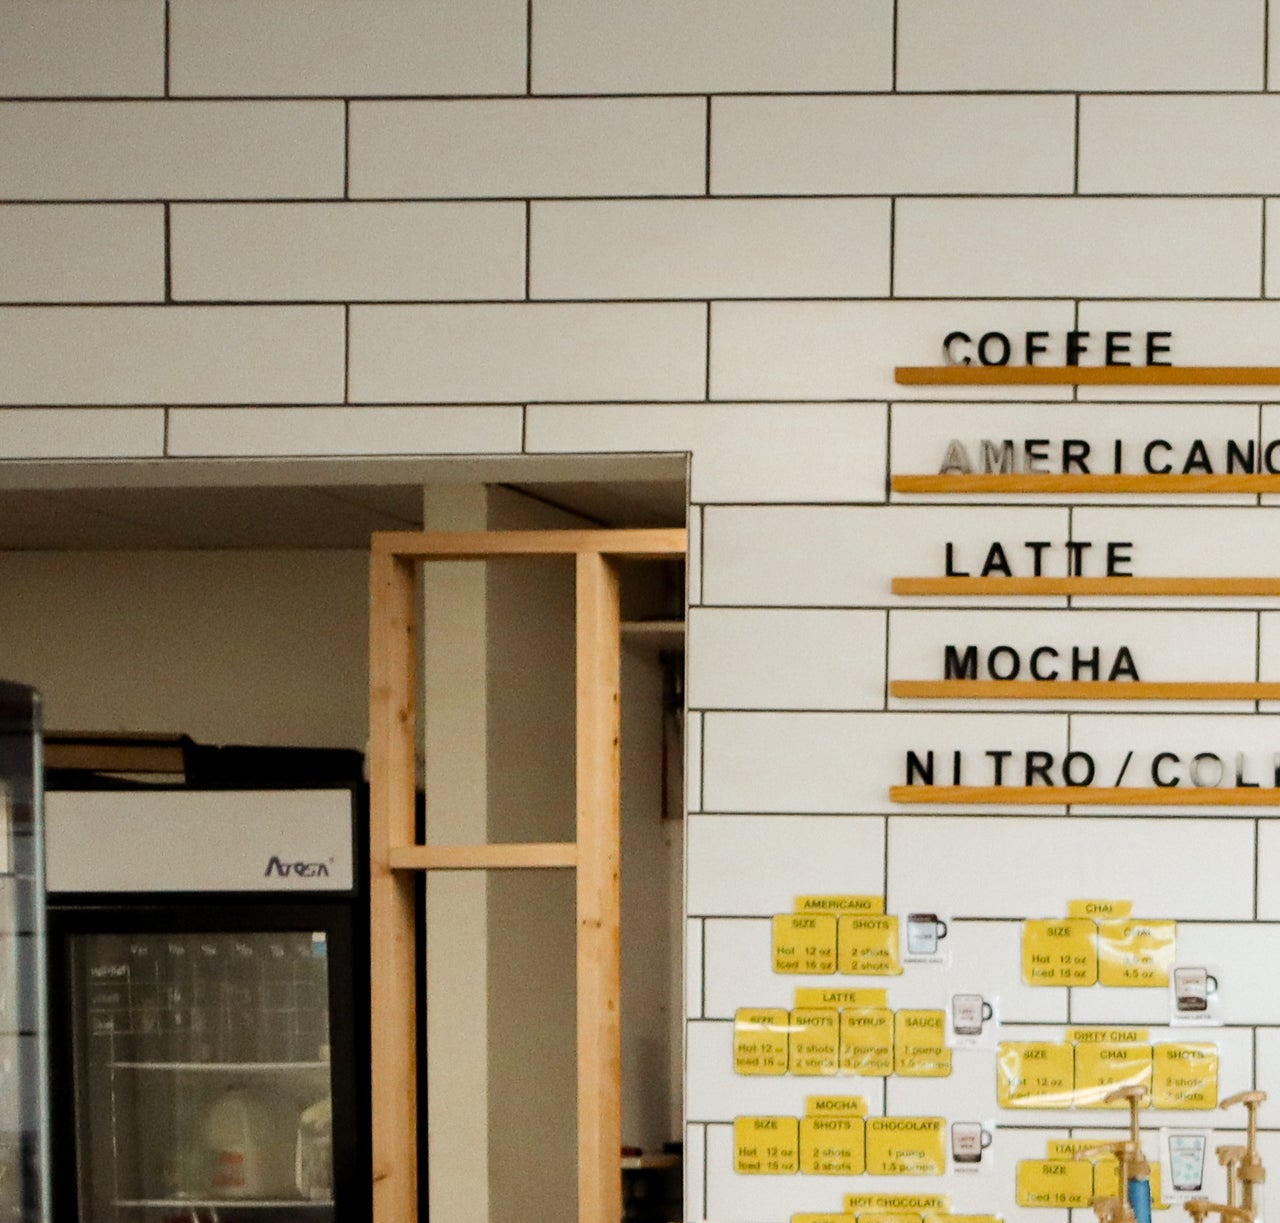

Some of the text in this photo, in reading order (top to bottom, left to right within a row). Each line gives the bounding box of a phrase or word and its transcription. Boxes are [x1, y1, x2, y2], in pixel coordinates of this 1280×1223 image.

[942, 331, 1173, 367] COFFEE
[944, 541, 1134, 578] LATTE
[944, 644, 1141, 681] MOCHA
[803, 899, 872, 911] AMERICANO
[1085, 904, 1113, 914] CHAI
[791, 919, 817, 930] SIZE
[851, 920, 890, 931] SHOTS
[1046, 928, 1072, 937] SIZE
[777, 946, 796, 957] Hot
[804, 946, 817, 957] 12
[776, 959, 799, 970] Iced
[861, 960, 890, 971] shots
[1031, 955, 1051, 965] Hot
[1060, 955, 1072, 965] 12
[823, 992, 857, 1003] LATTE
[796, 1016, 834, 1027] SHOTS
[848, 1016, 887, 1027] SYRUP
[904, 1017, 943, 1028] SAUCE
[1073, 1031, 1138, 1042] DIRTY CHAI
[911, 1047, 943, 1058] pump
[1024, 1050, 1048, 1060] SIZE
[1099, 1051, 1127, 1060] CHAI
[1166, 1051, 1205, 1061] SHOTS
[816, 1100, 857, 1110] MOCHA
[754, 1120, 778, 1130] SIZE
[813, 1120, 851, 1131] SHOTS
[872, 1121, 941, 1131] CHOCOLATE
[738, 1147, 758, 1157] Hot
[766, 1147, 778, 1157] 12
[895, 1150, 926, 1162] pump
[738, 1161, 761, 1171] Iced
[821, 1162, 852, 1172] shots
[1042, 1166, 1067, 1176] SIZE
[850, 1198, 944, 1209] HOT CHOCOLATE
